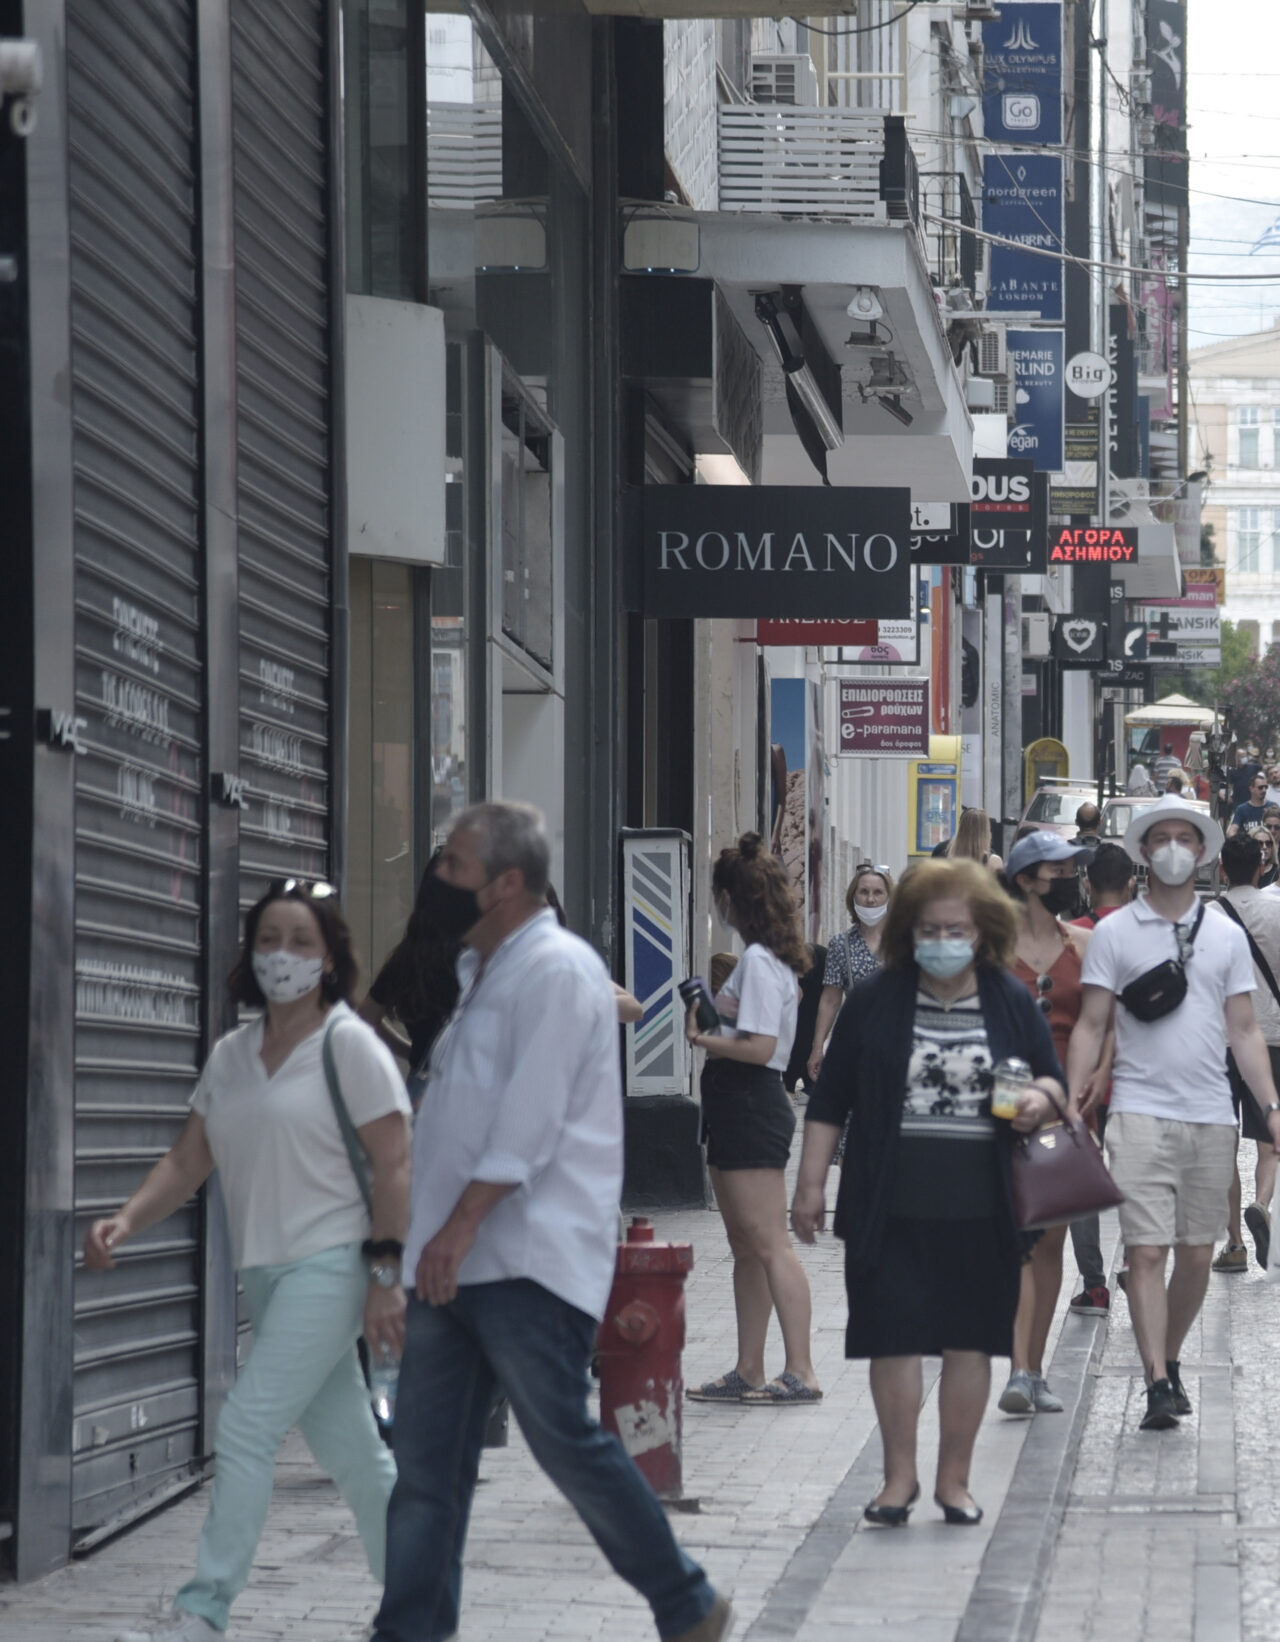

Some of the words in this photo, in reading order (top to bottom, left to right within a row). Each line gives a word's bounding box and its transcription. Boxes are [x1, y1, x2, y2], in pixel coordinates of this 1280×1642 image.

[1008, 55, 1056, 65] OLYMPUS
[1009, 101, 1032, 118] Go
[987, 186, 1057, 199] nordgreen
[999, 293, 1044, 301] LONDON
[1072, 365, 1104, 383] Big
[1059, 529, 1125, 545] ΑΓΟΡΑ
[657, 531, 897, 572] ROMANO
[1050, 545, 1134, 561] ΑΣΗΜΙΟΥ
[842, 689, 924, 702] ΕΠΙΔΙΟΡΘΩΣΕΙΣ
[880, 703, 923, 716] ρούχων
[991, 682, 1000, 737] ANATOMIC
[841, 723, 922, 739] e-paramana
